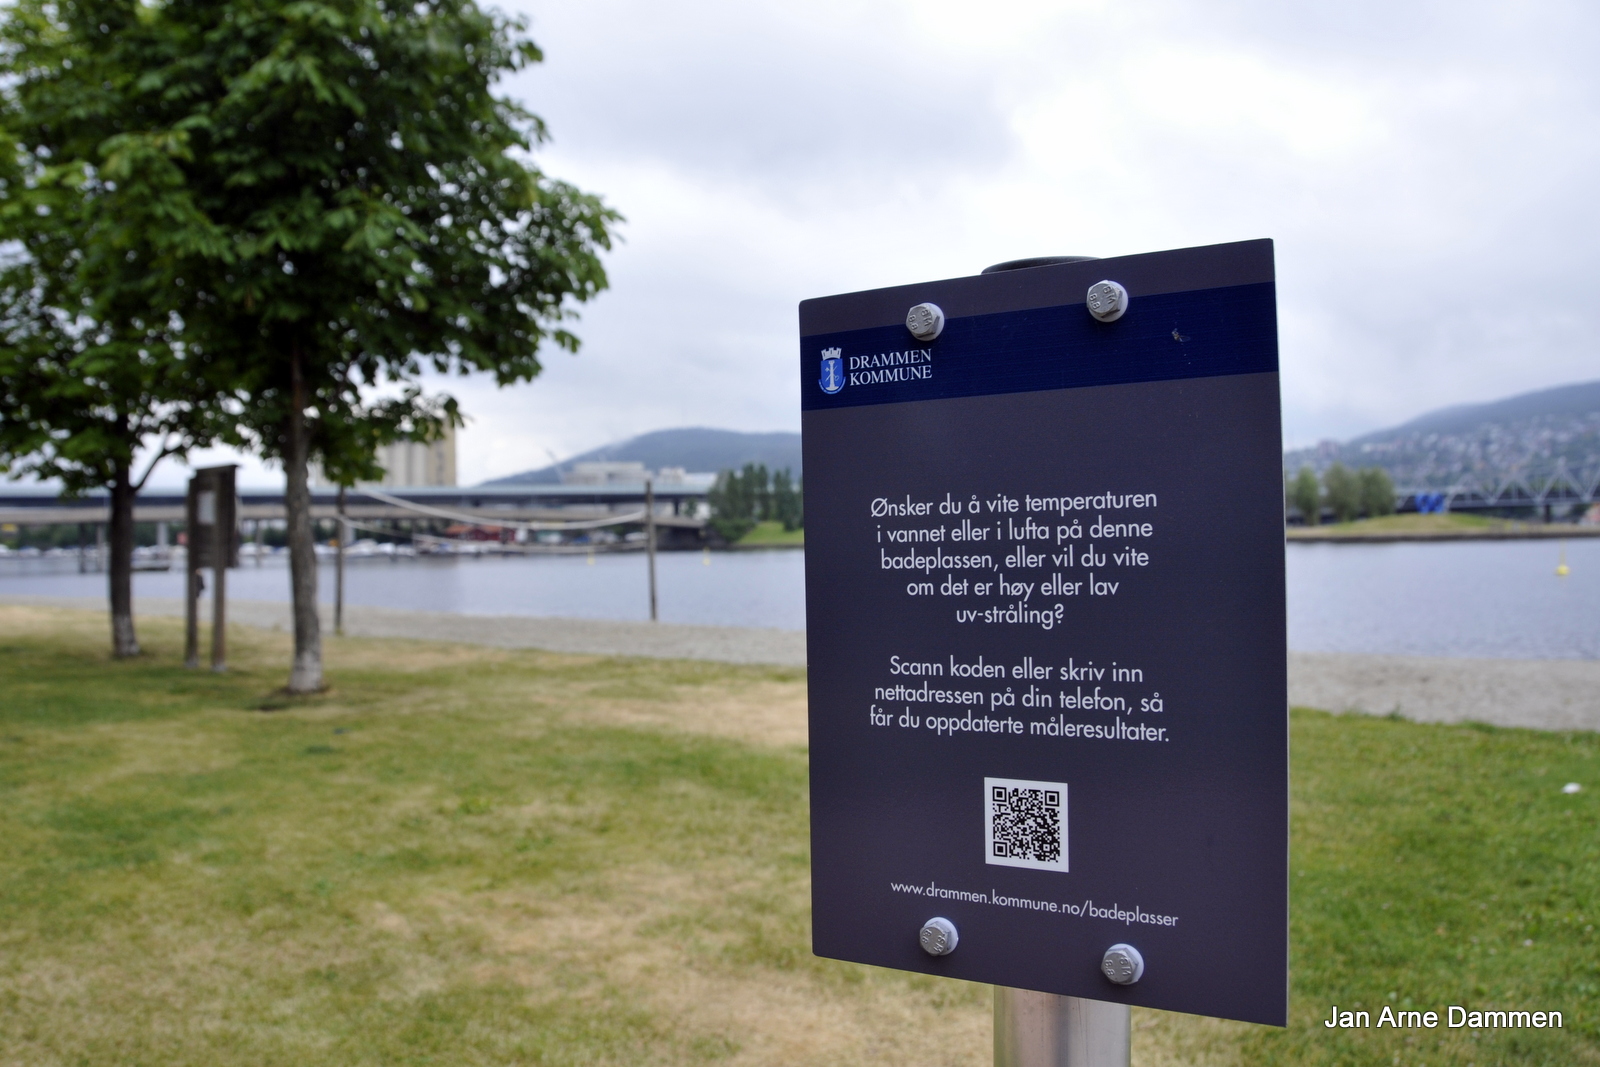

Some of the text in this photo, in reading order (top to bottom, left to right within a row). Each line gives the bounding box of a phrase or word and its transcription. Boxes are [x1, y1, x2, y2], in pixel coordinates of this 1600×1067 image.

[849, 348, 932, 370] DRAMMEN
[849, 365, 932, 386] KOMMUNE
[871, 491, 1157, 517] Ønsker du å vite temperaturen
[876, 515, 1153, 545] i vannet eller i lufta på denne
[881, 544, 1149, 574] badeplassen, eller vil du vite
[907, 572, 1119, 601] om det er høy eller lav
[957, 601, 1064, 630] uv-stråling?
[890, 655, 1142, 682] Scann koden eller skriv inn
[875, 681, 1163, 715] nettadressen på din telefon, så
[870, 704, 1169, 742] får du oppdaterte måleresultater.
[891, 882, 1178, 926] www.drammen.kommune.no/badeplasser
